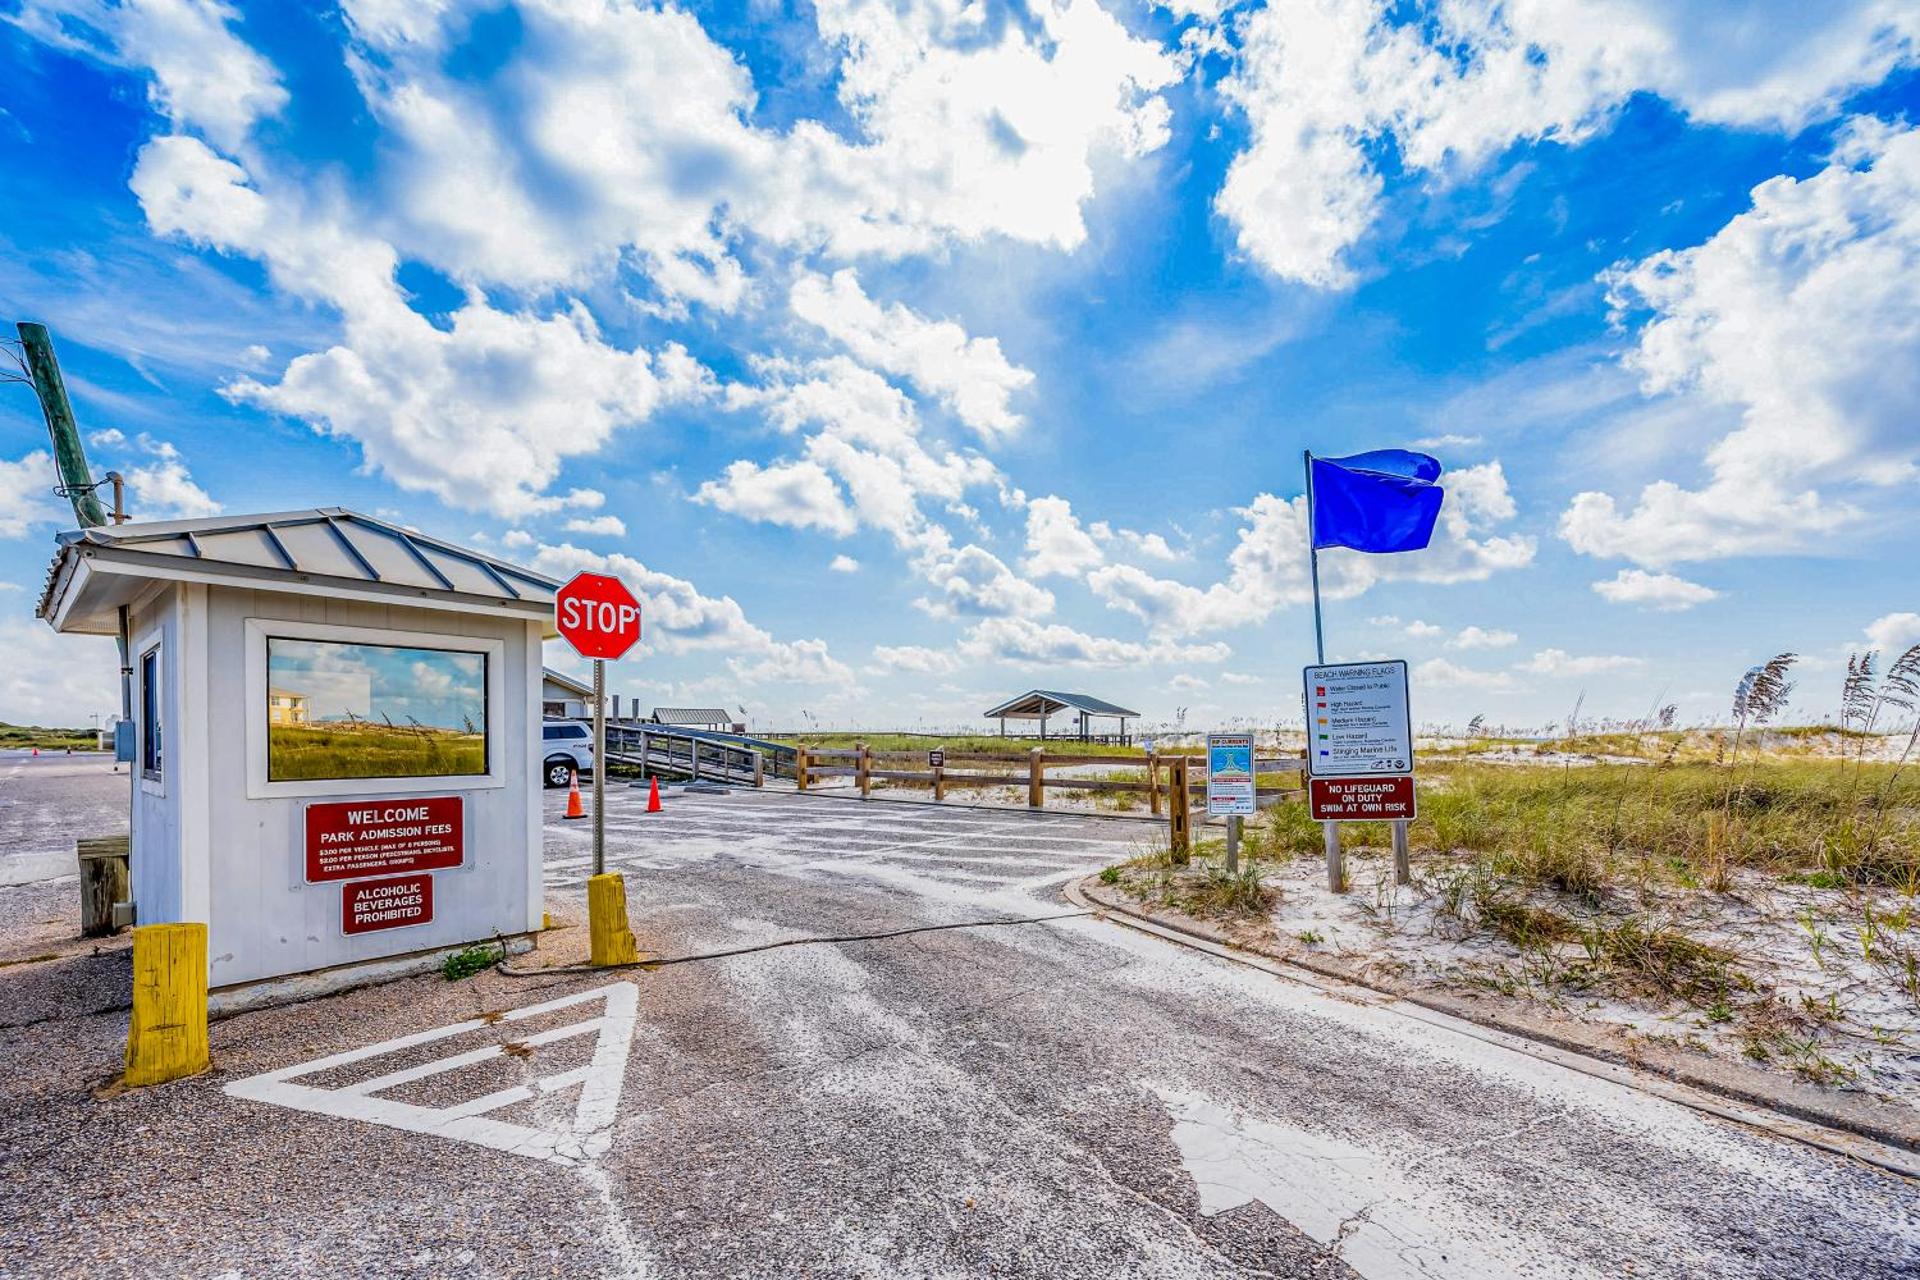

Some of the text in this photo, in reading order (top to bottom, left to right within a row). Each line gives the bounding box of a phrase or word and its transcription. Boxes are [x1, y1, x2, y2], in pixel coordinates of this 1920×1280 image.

[562, 597, 637, 634] STOP
[1313, 671, 1337, 679] BEACH
[1338, 668, 1371, 678] WARNING
[1371, 666, 1396, 675] FLAGS
[1360, 746, 1383, 754] Marine
[1329, 784, 1396, 794] NO LIFEGUARD
[1341, 793, 1383, 803] ON DUTY
[1320, 802, 1407, 813] SWIM AT OWN RISK
[347, 807, 430, 825] WELCOME
[320, 824, 452, 844] PARK ADMISSION FEES
[353, 853, 379, 861] PERSON
[323, 864, 346, 873] EXTRA
[356, 883, 421, 900] ALCOHOLIC
[353, 894, 424, 913] BEVERAGES
[355, 906, 423, 924] PROHIBITED
